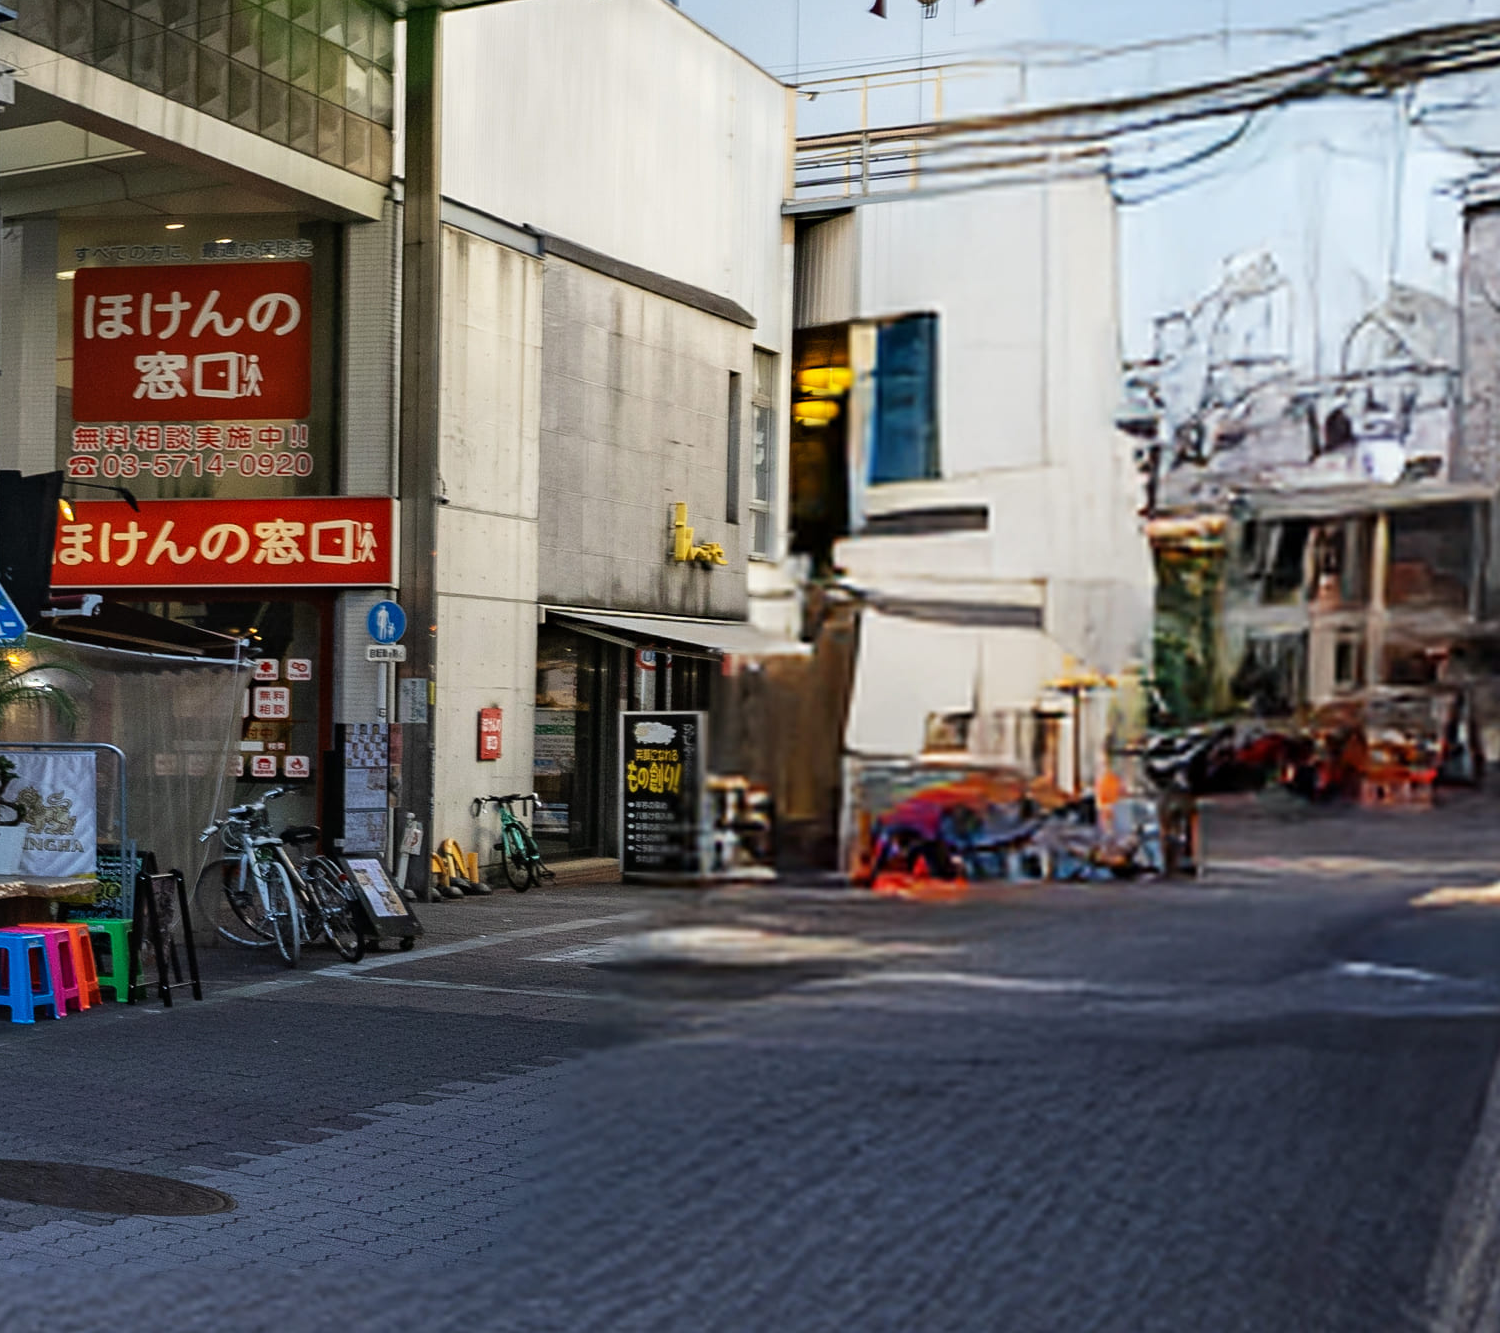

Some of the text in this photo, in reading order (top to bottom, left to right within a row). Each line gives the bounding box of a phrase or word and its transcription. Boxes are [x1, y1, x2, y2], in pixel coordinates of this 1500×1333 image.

[83, 289, 301, 340] ほけんの
[72, 425, 309, 452] 無料相談実施中!!
[102, 453, 313, 479] 03-5714-0920
[24, 836, 85, 854] INGHA
